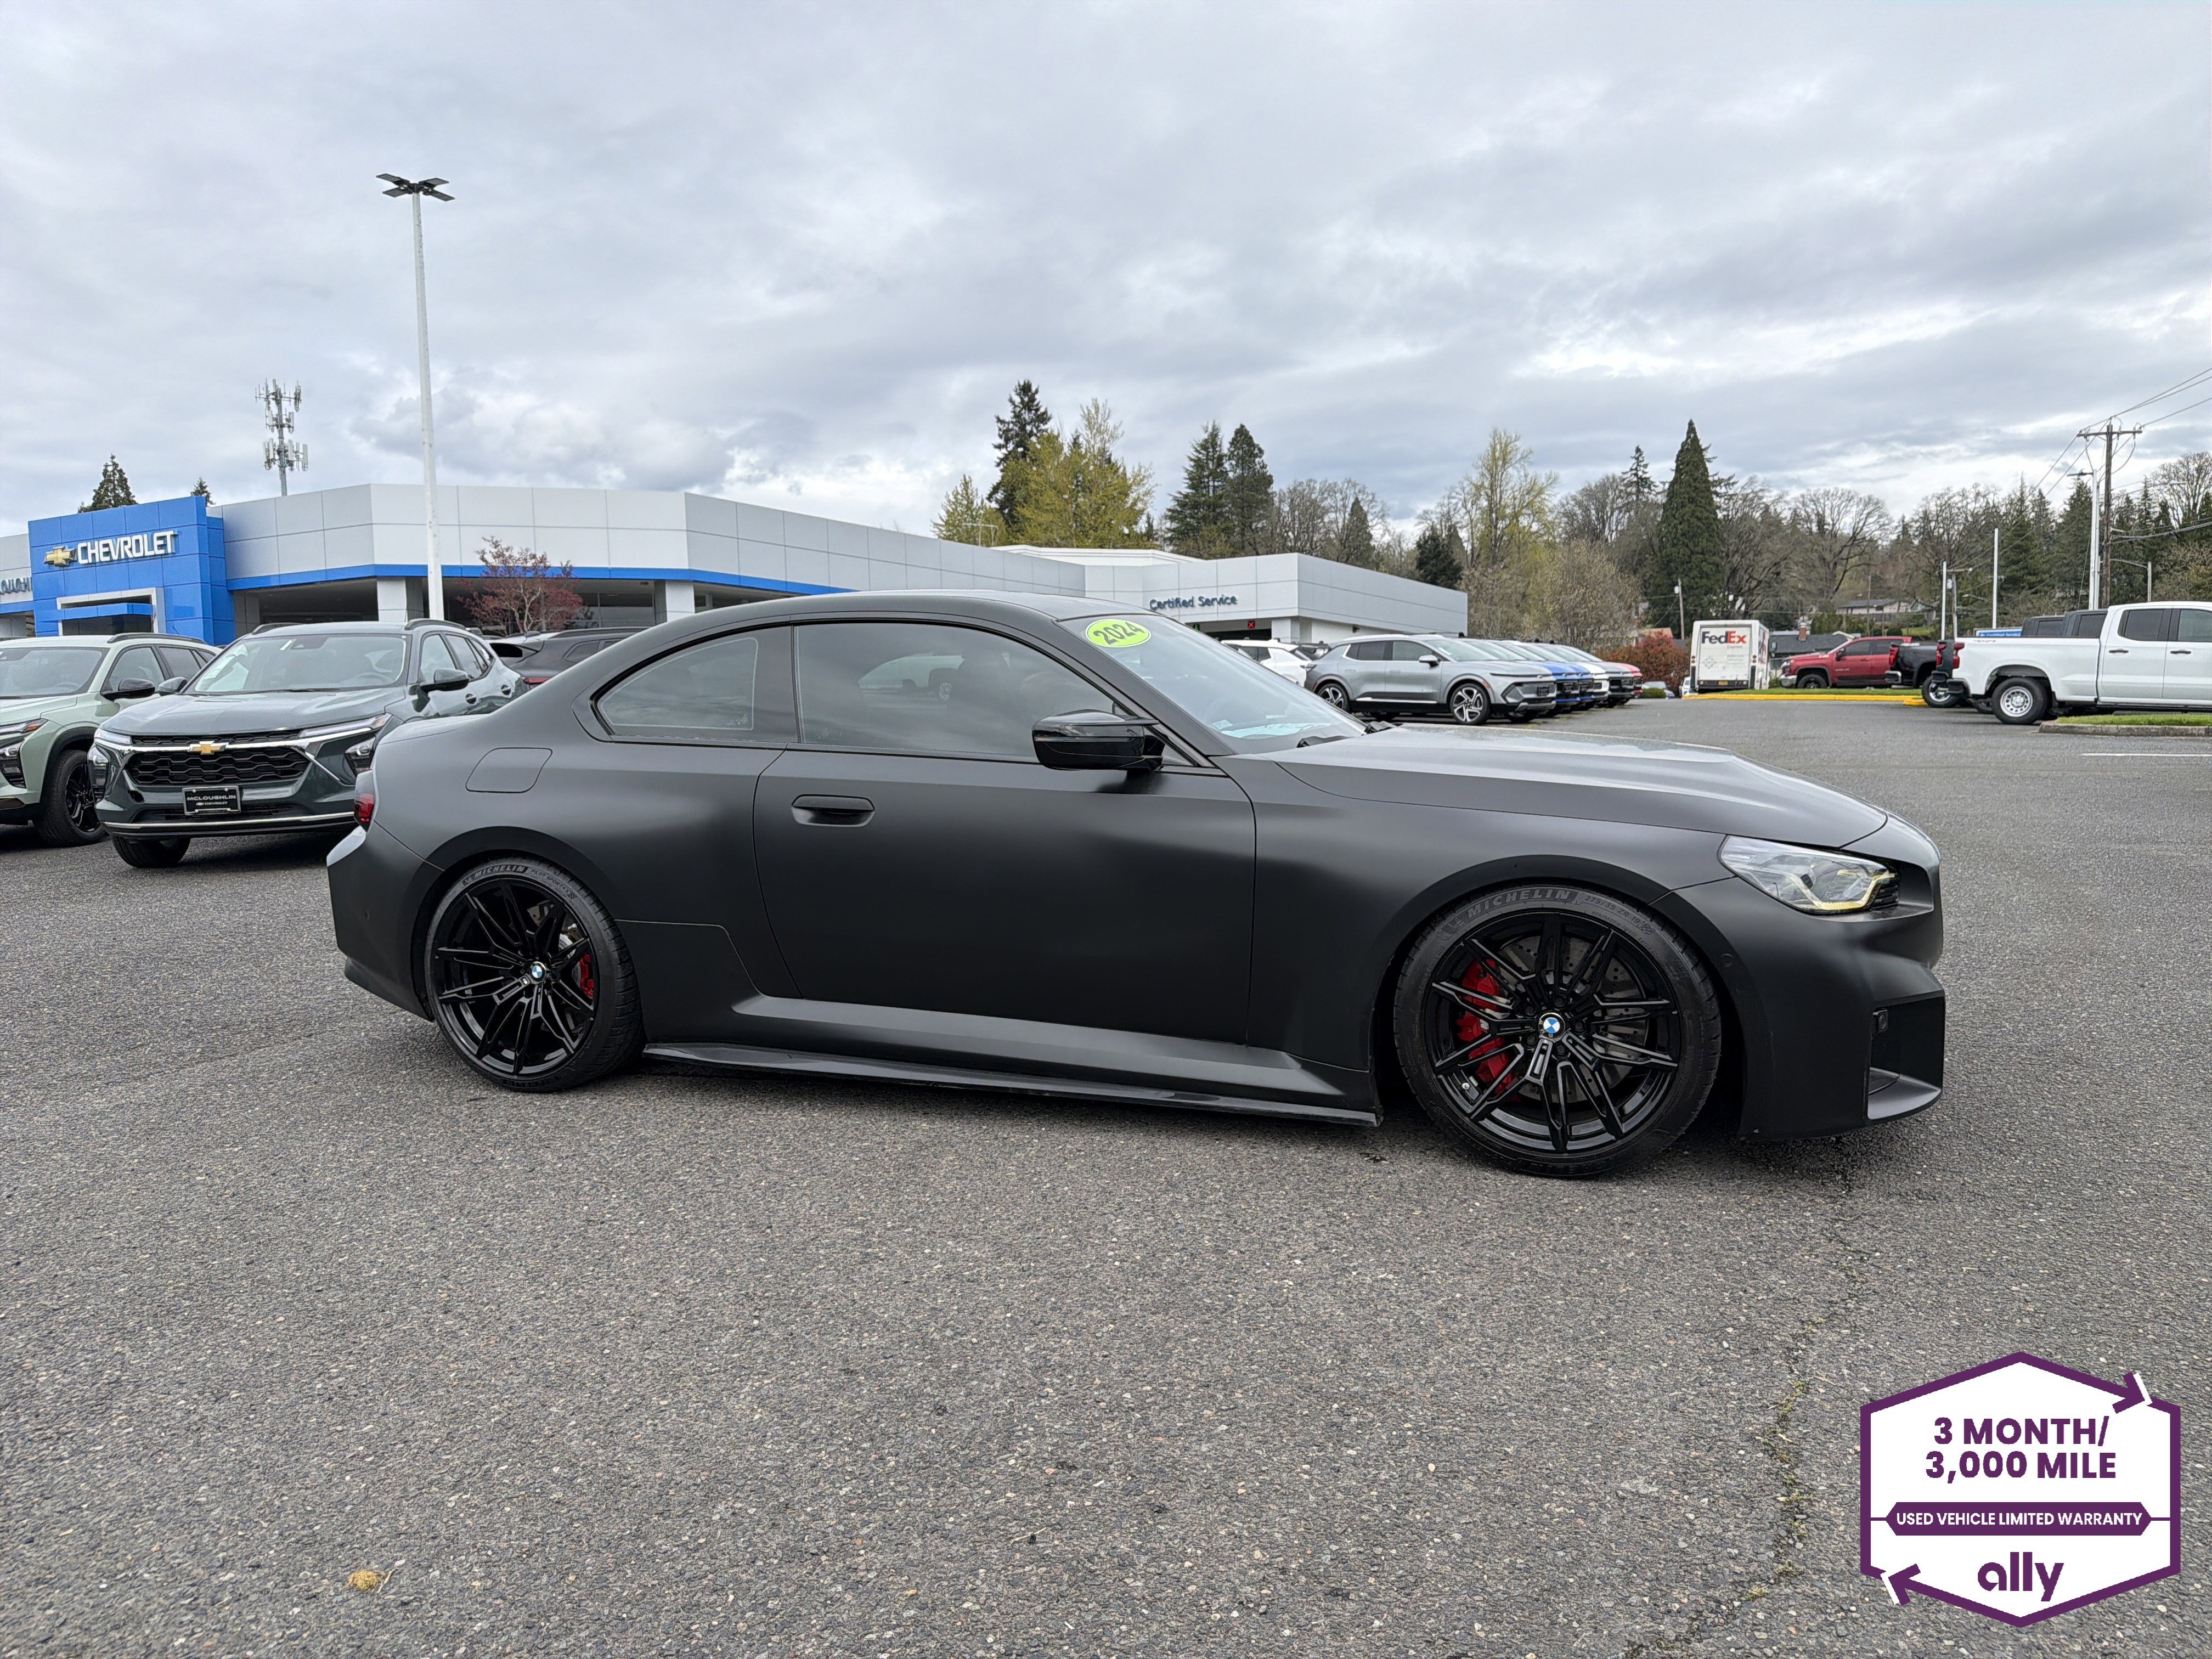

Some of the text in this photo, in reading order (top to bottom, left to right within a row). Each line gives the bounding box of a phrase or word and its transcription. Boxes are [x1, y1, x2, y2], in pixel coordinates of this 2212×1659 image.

[77, 530, 175, 564] CHEVROLET
[1149, 594, 1238, 611] Certified Service
[1093, 622, 1146, 645] 2024
[1701, 630, 1747, 644] FedEx
[475, 865, 526, 878] MICHELIN
[531, 869, 546, 877] PILOT
[1468, 888, 1571, 919] MICHELIN
[1584, 895, 1615, 910] 275/35
[1617, 908, 1629, 918] ZR
[1631, 916, 1641, 925] 19
